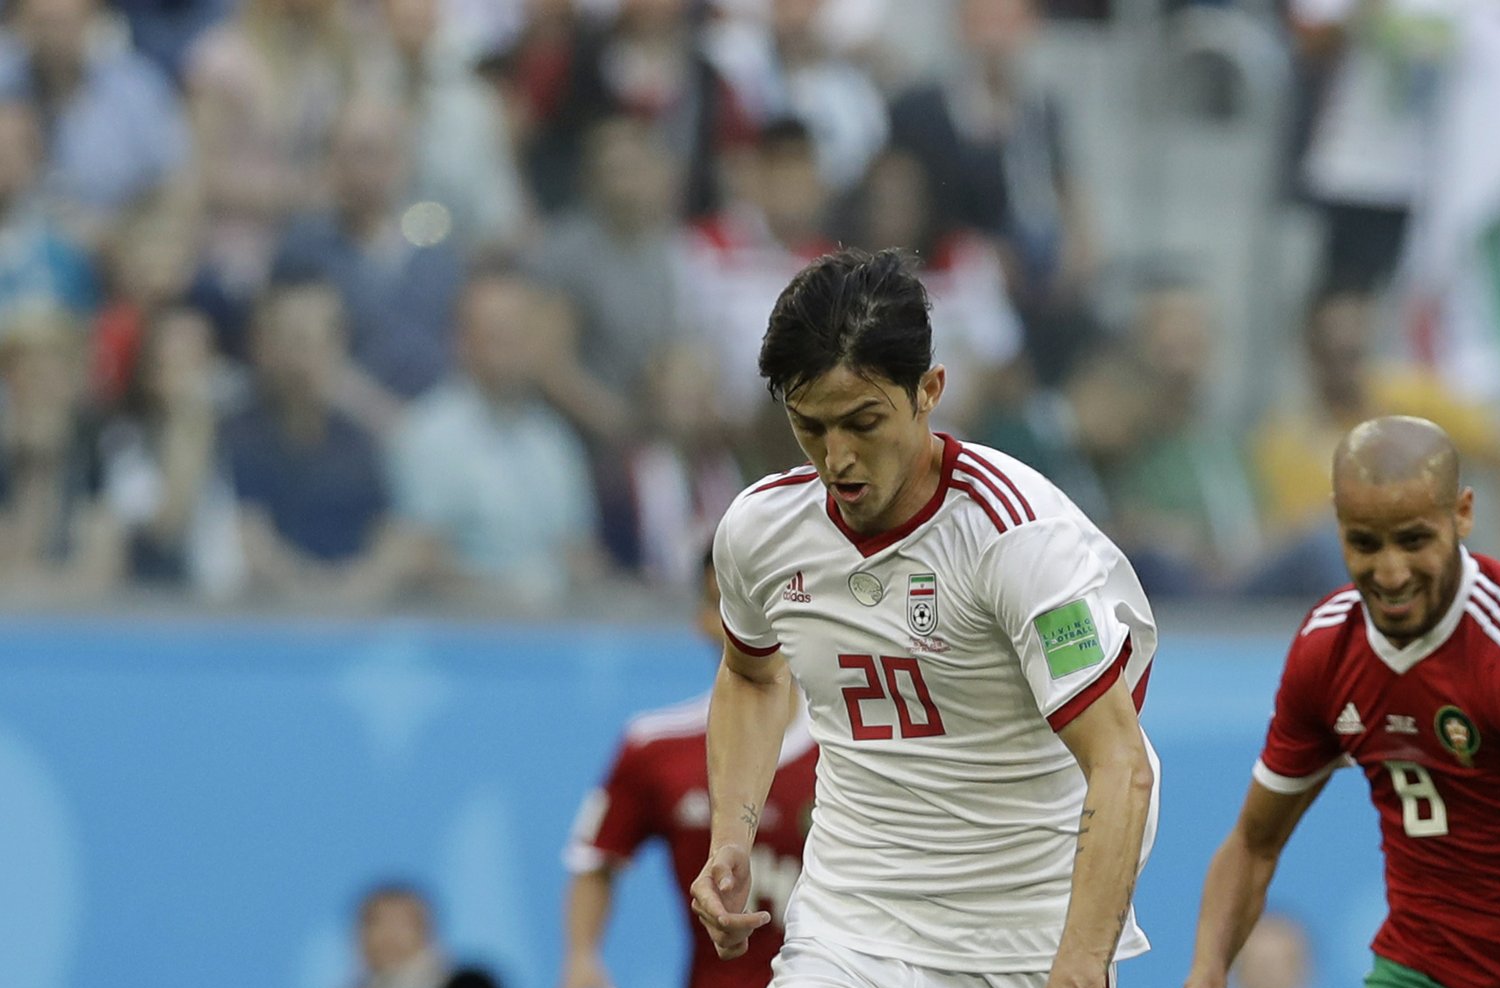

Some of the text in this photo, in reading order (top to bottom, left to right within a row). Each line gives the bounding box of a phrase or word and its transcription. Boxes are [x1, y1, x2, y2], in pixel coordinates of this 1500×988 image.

[1079, 640, 1098, 651] FIFA
[838, 653, 947, 741] 20
[1384, 761, 1449, 838] 8
